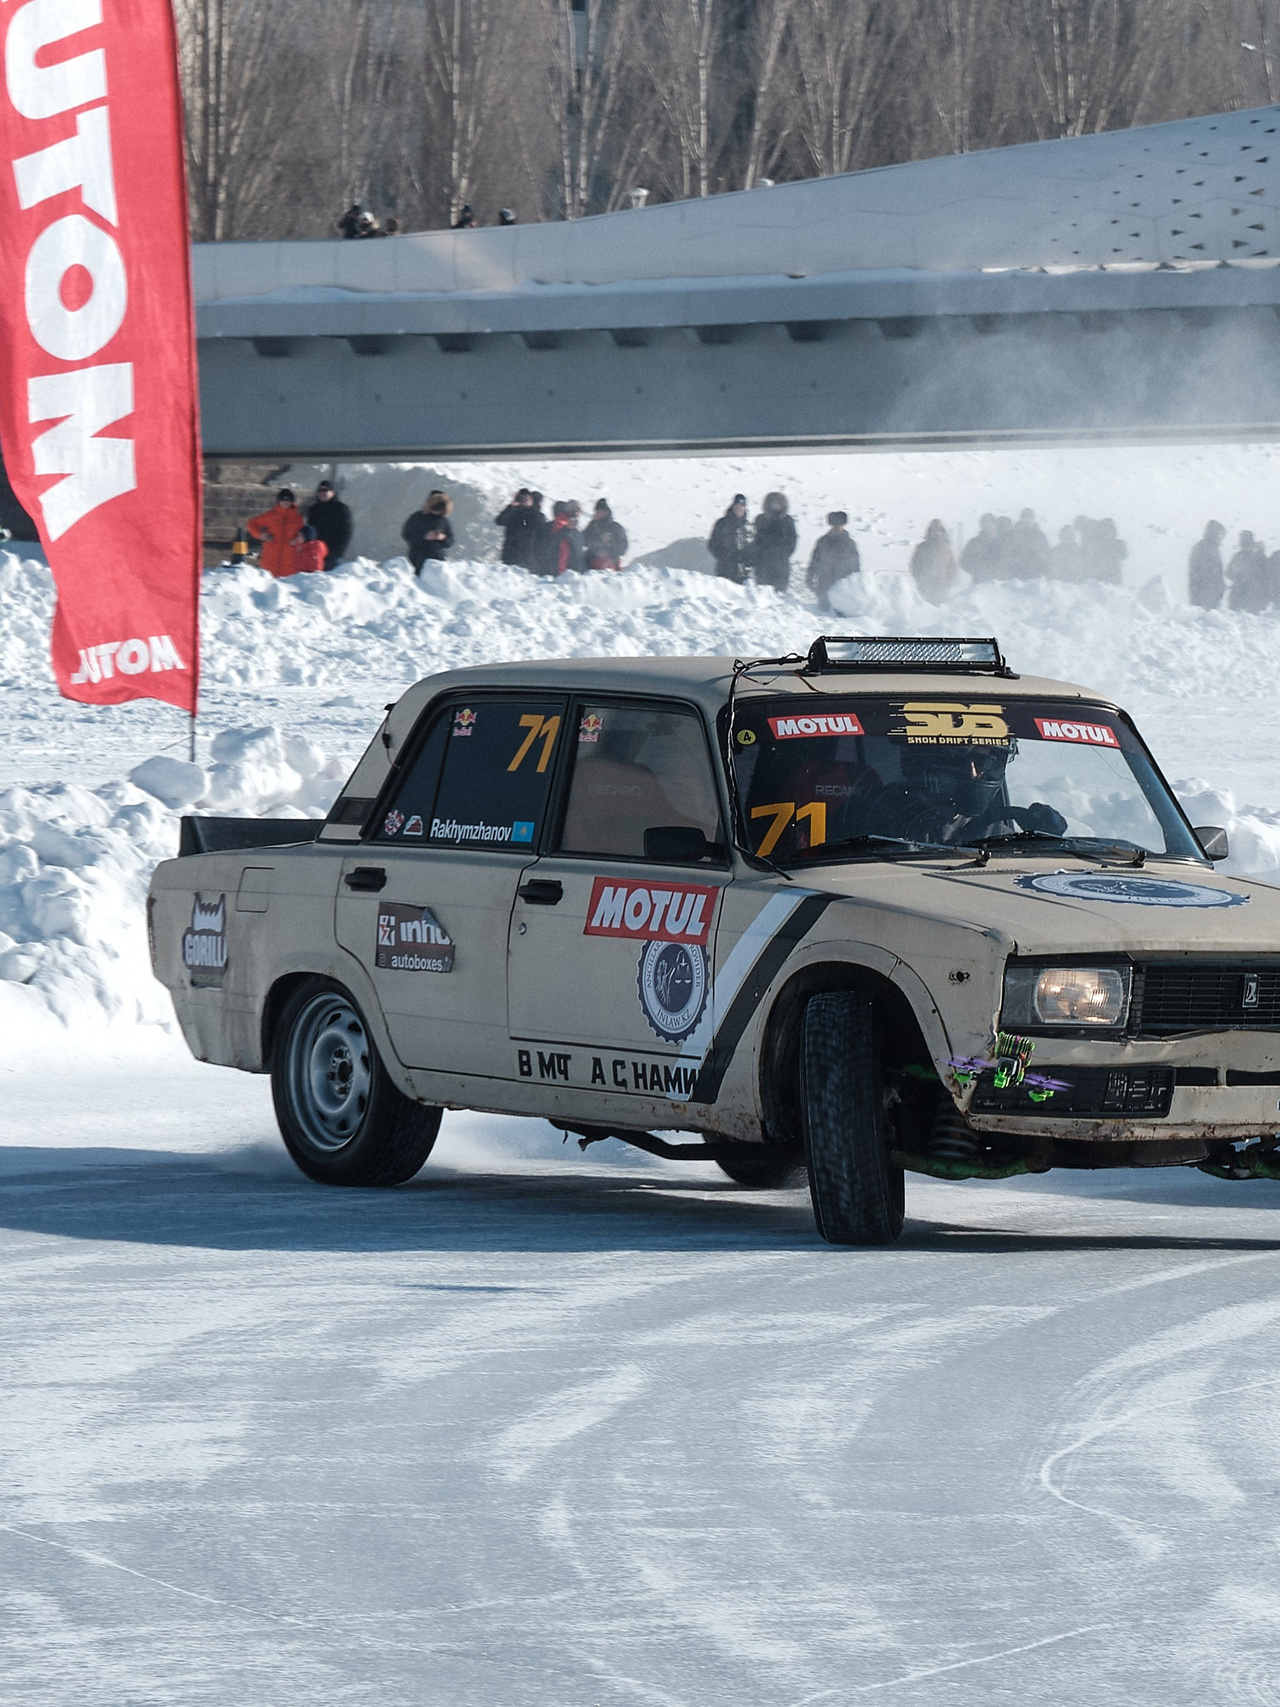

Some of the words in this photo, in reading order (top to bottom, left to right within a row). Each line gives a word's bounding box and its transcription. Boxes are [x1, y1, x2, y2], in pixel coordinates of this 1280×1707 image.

[776, 715, 859, 736] MOTUL
[907, 736, 937, 745] SNOW
[938, 736, 969, 746] DRIFT
[971, 737, 1009, 747] SERIES
[1042, 720, 1115, 744] MOTUL
[506, 714, 561, 773] 71
[430, 818, 511, 843] Rakhymzhanov
[751, 802, 826, 858] 71
[591, 886, 707, 936] MOTUL
[646, 942, 664, 988] ANCILLAR
[689, 945, 701, 988] ROVIDER
[656, 1008, 691, 1028] INLAW.KZ
